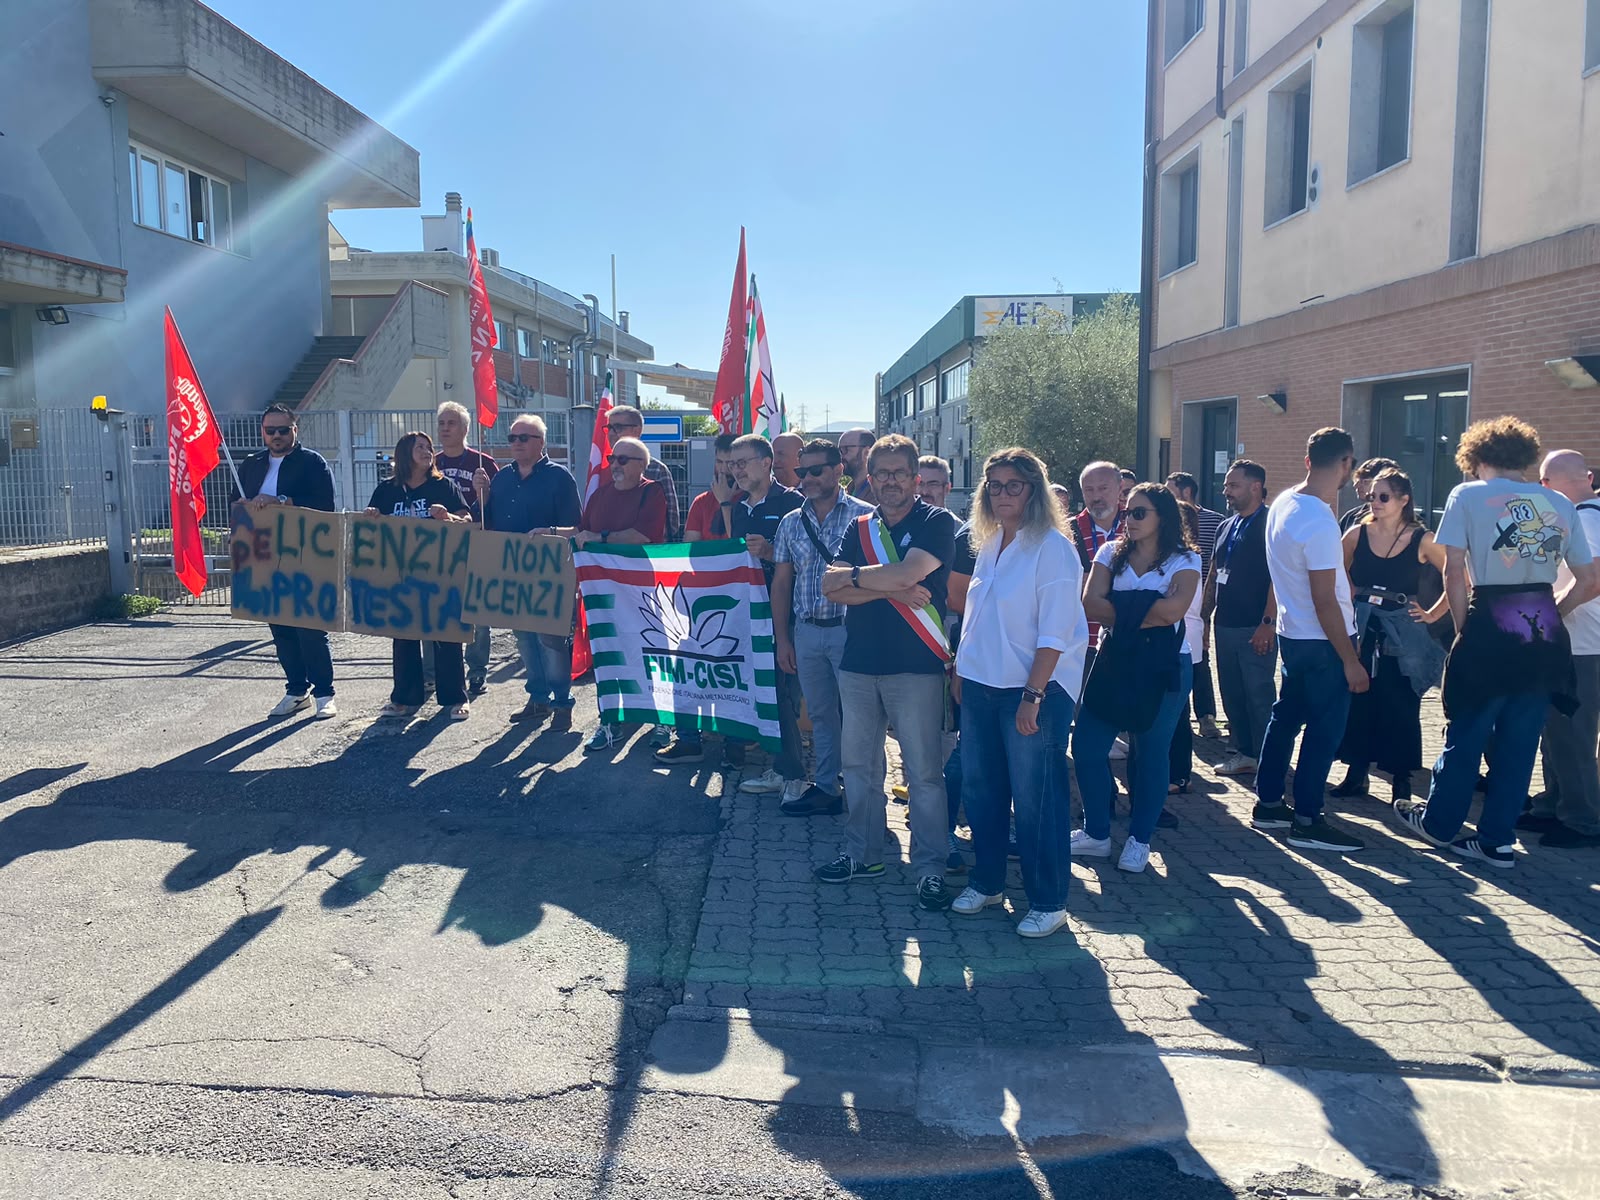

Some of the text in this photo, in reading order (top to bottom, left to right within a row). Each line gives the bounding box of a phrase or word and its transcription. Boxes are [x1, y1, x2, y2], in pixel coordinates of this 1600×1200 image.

[502, 537, 562, 575] NON
[271, 570, 471, 635] PROTESTA
[463, 572, 564, 619] LICENZI
[643, 655, 749, 692] FIM-CISL
